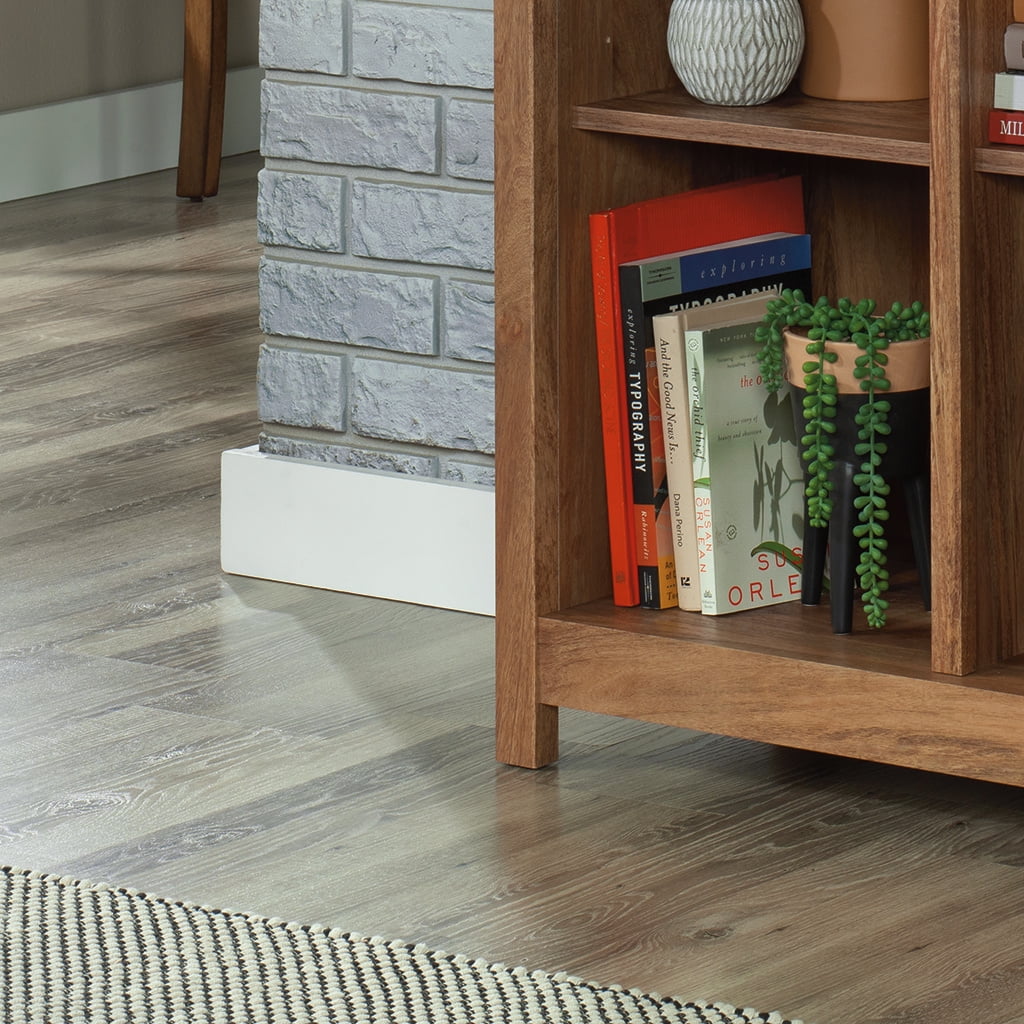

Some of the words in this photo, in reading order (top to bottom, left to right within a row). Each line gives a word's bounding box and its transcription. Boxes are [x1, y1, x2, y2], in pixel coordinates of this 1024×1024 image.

[700, 253, 787, 279] exploring
[627, 308, 638, 365] exploring
[660, 337, 672, 360] And
[661, 359, 672, 378] the
[691, 367, 700, 382] the
[740, 375, 753, 389] the
[663, 381, 675, 413] Good
[692, 385, 704, 426] orchid
[629, 372, 646, 472] TYPOGRAPHY
[666, 411, 676, 440] News
[694, 428, 706, 463] thief
[673, 493, 681, 517] Dana
[695, 497, 707, 573] ORLEAN
[703, 497, 712, 552] SUSAN
[757, 547, 802, 571] SUS
[728, 574, 801, 606] ORLE
